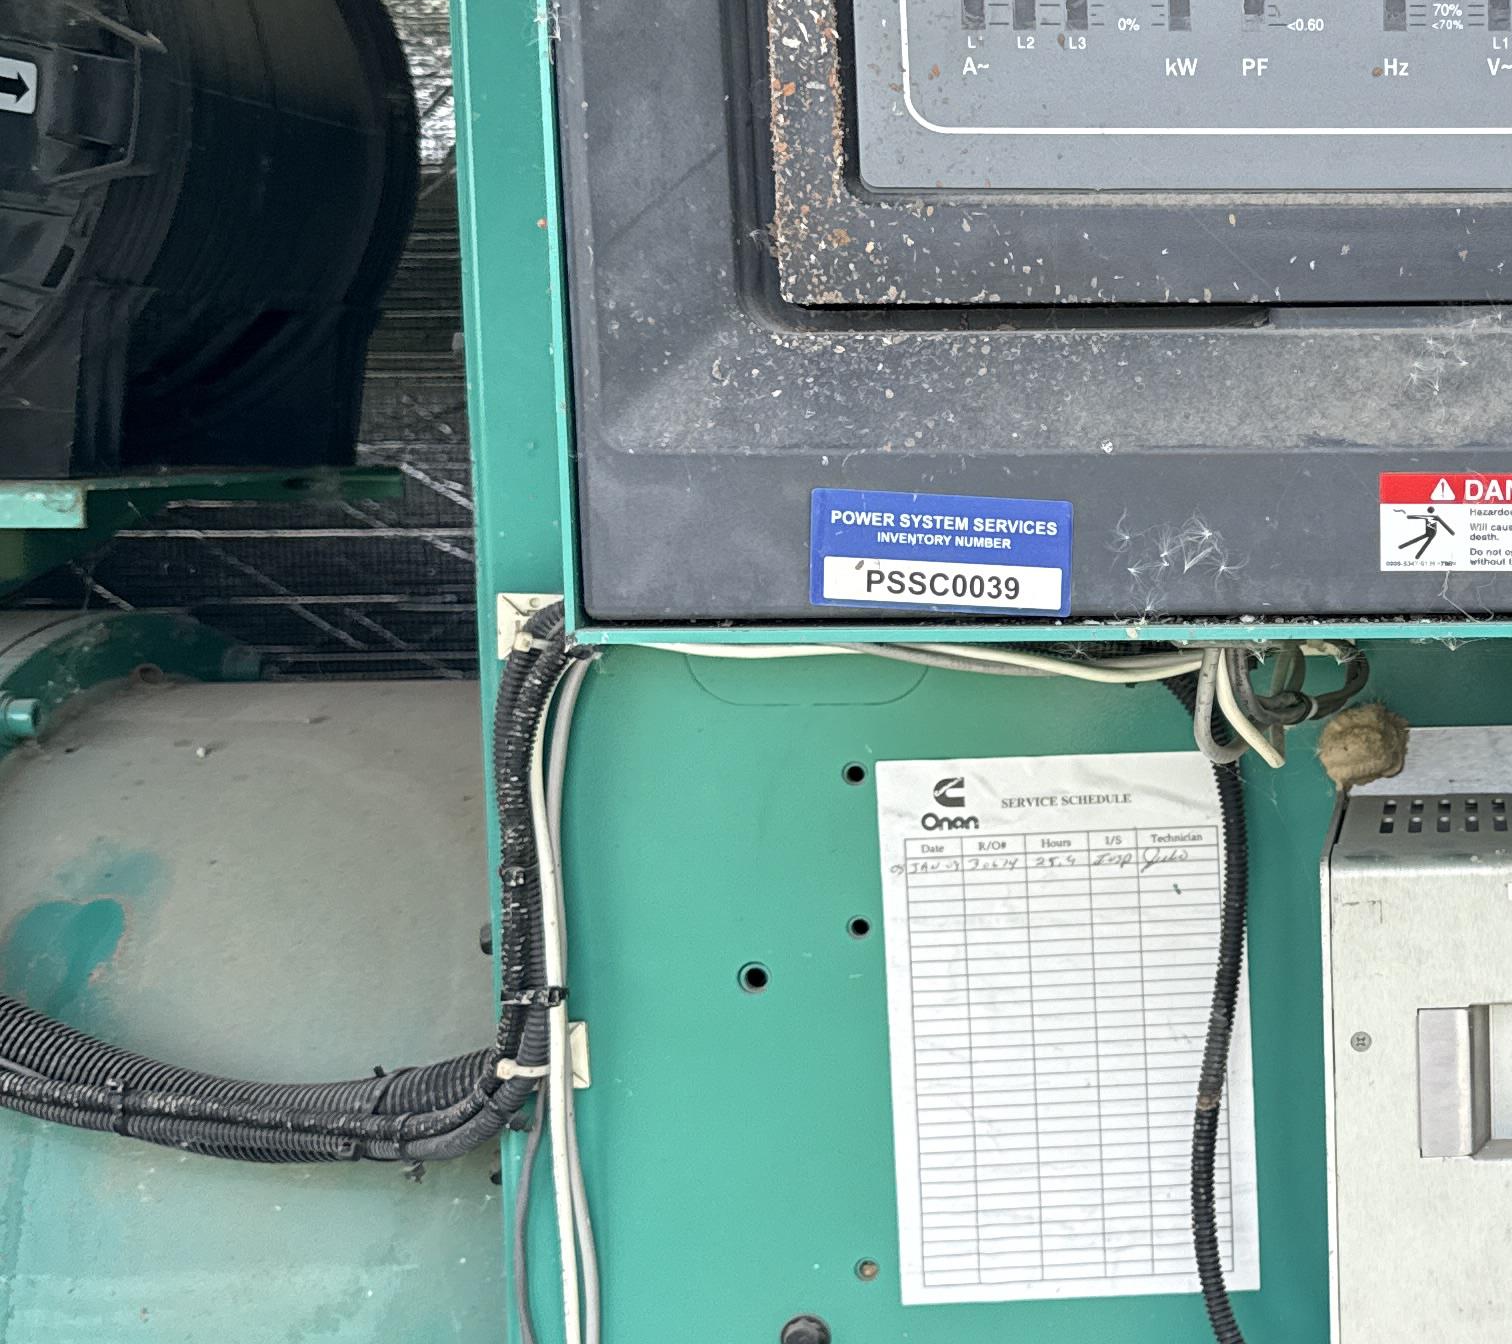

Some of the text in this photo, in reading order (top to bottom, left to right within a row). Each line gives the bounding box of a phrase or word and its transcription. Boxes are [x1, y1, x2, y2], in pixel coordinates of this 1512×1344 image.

[1433, 4, 1462, 16] 70%
[1117, 19, 1140, 31] 0%
[1287, 19, 1324, 31] <0.60
[1432, 20, 1464, 31] <70%
[1017, 37, 1035, 49] L2
[1068, 37, 1087, 49] L3
[1492, 37, 1509, 50] L1
[1165, 58, 1198, 76] kW
[1242, 58, 1269, 76] PF
[1383, 58, 1409, 76] Hz
[831, 510, 1058, 536] POWER SYSTEM SERVICES
[1470, 523, 1488, 531] Will
[877, 531, 1012, 549] INVENTORY NUMBER
[1470, 533, 1499, 541] death.
[1470, 548, 1483, 556] Do
[1486, 548, 1501, 556] not
[1470, 558, 1506, 566] without
[866, 570, 1020, 600] PSSC0039
[1001, 793, 1132, 809] SERVICE SCHEDULE
[921, 812, 979, 831] Onan
[921, 843, 945, 854] Date
[978, 841, 1007, 852] R/O#
[1041, 837, 1072, 848] Hours
[1150, 832, 1203, 844] Technician
